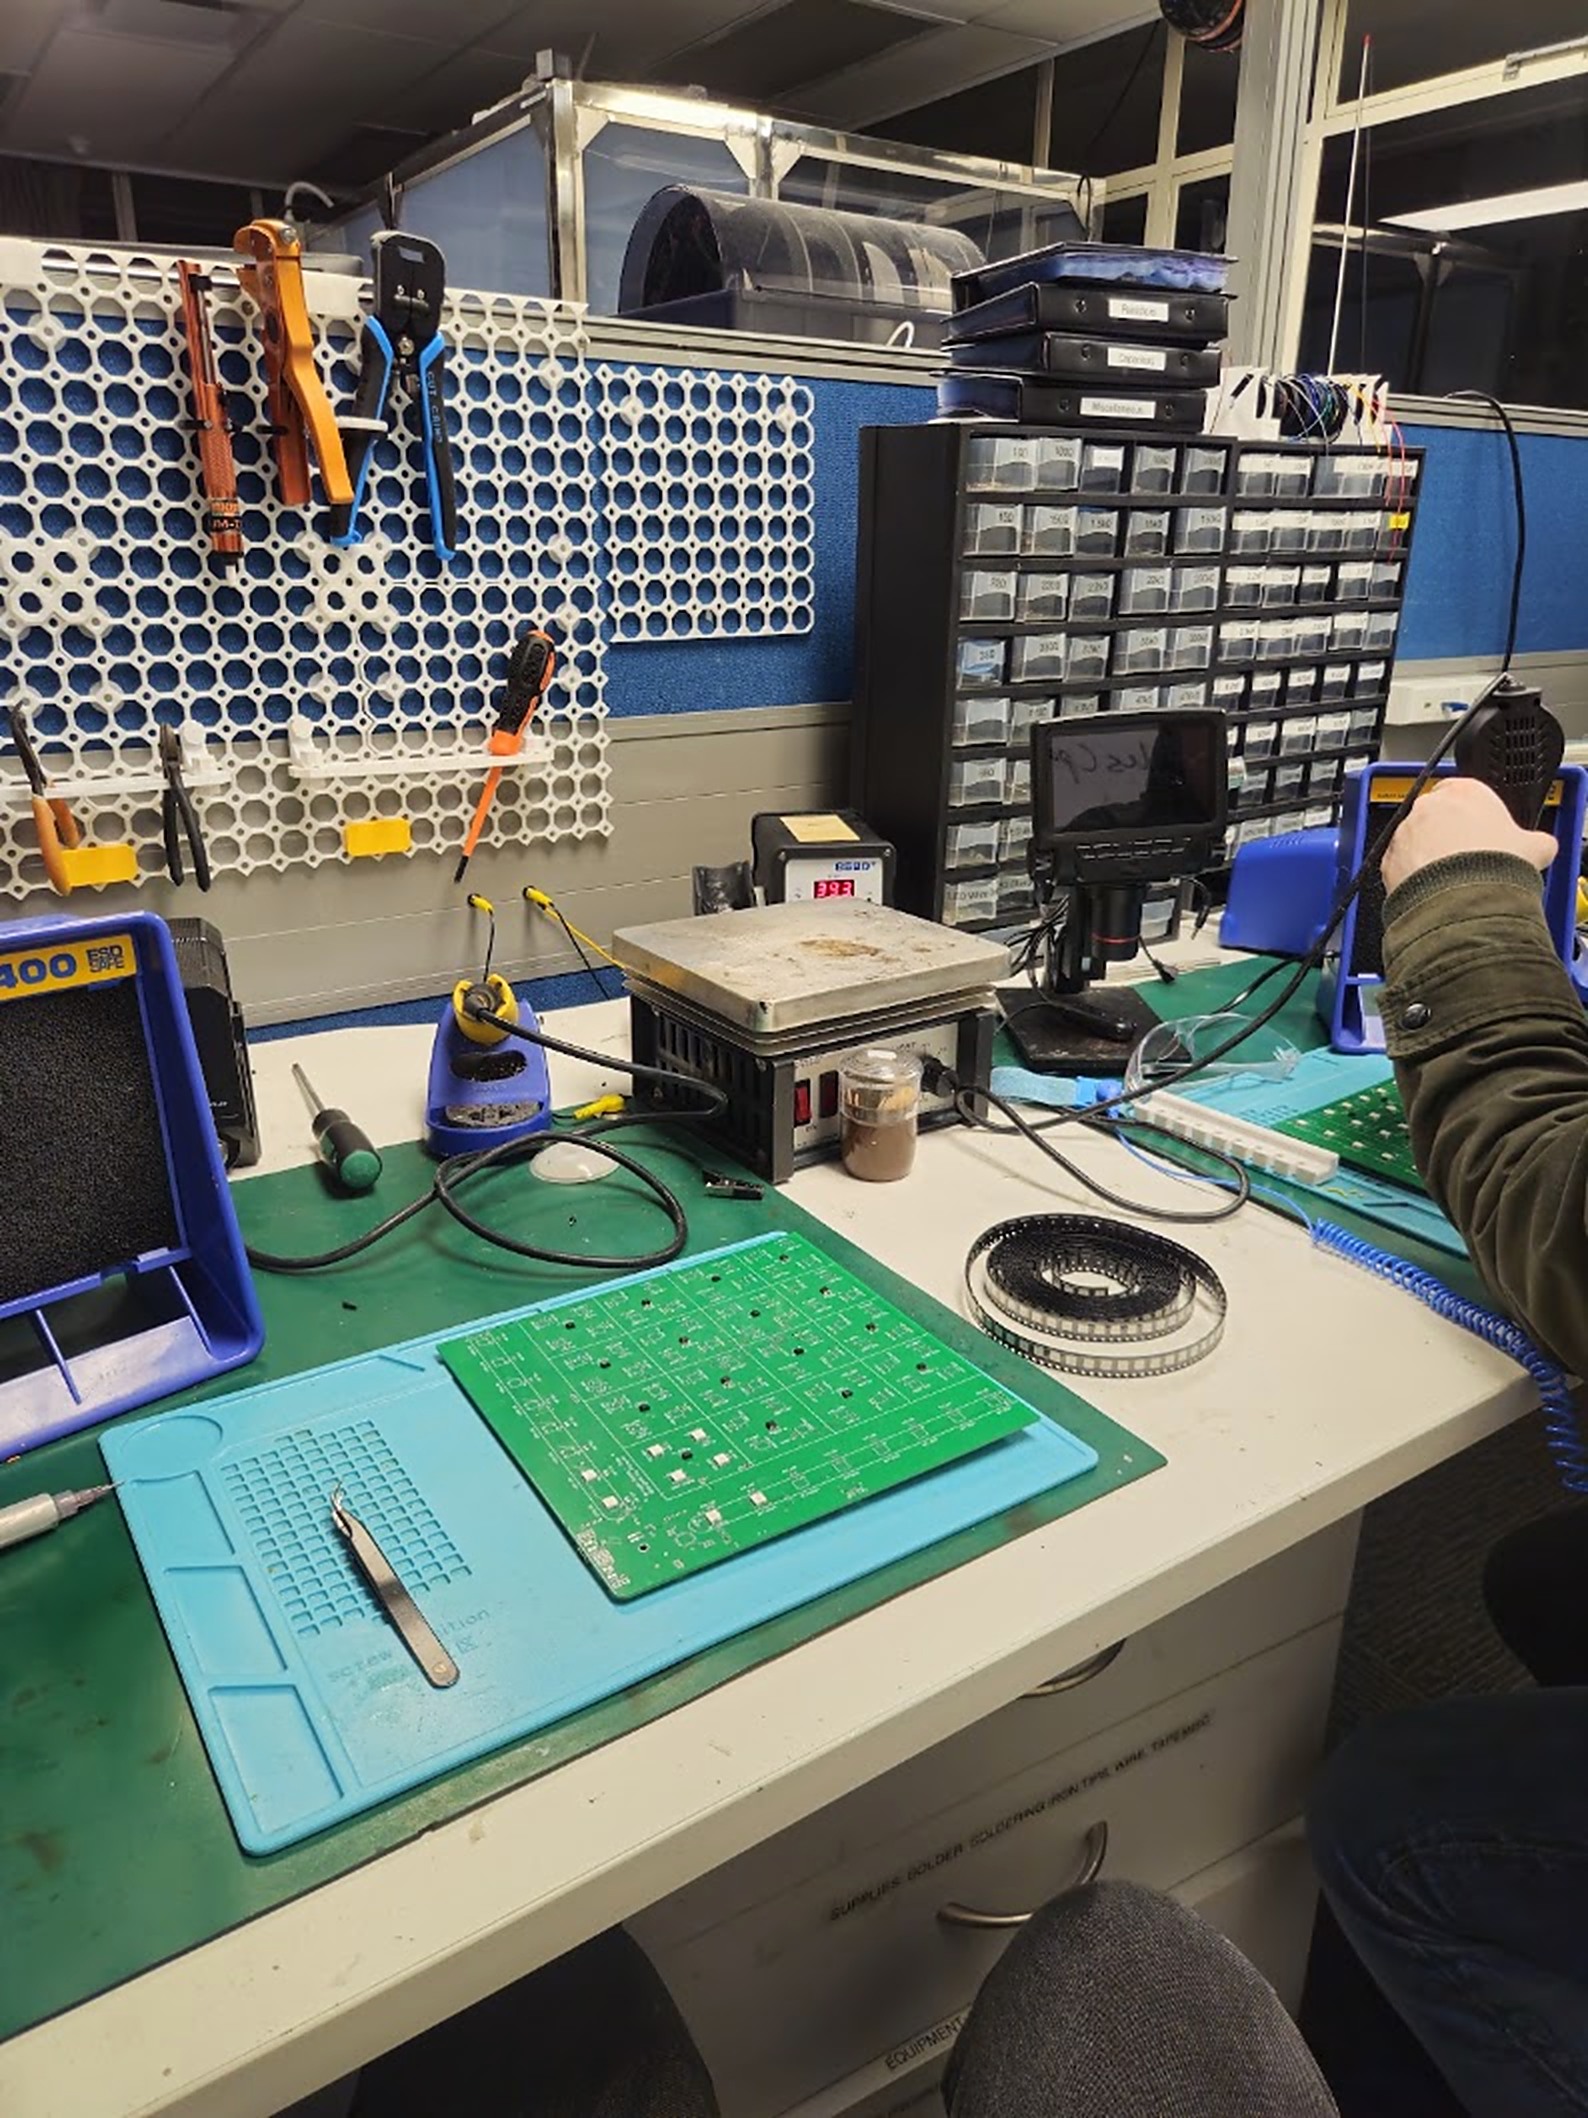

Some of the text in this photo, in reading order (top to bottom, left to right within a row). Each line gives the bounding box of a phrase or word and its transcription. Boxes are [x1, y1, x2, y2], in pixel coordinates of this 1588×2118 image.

[427, 371, 437, 396] CUT
[86, 945, 124, 961] ESD
[830, 1876, 902, 1921] SUPPLIES
[969, 1802, 1047, 1850] SOLDERING
